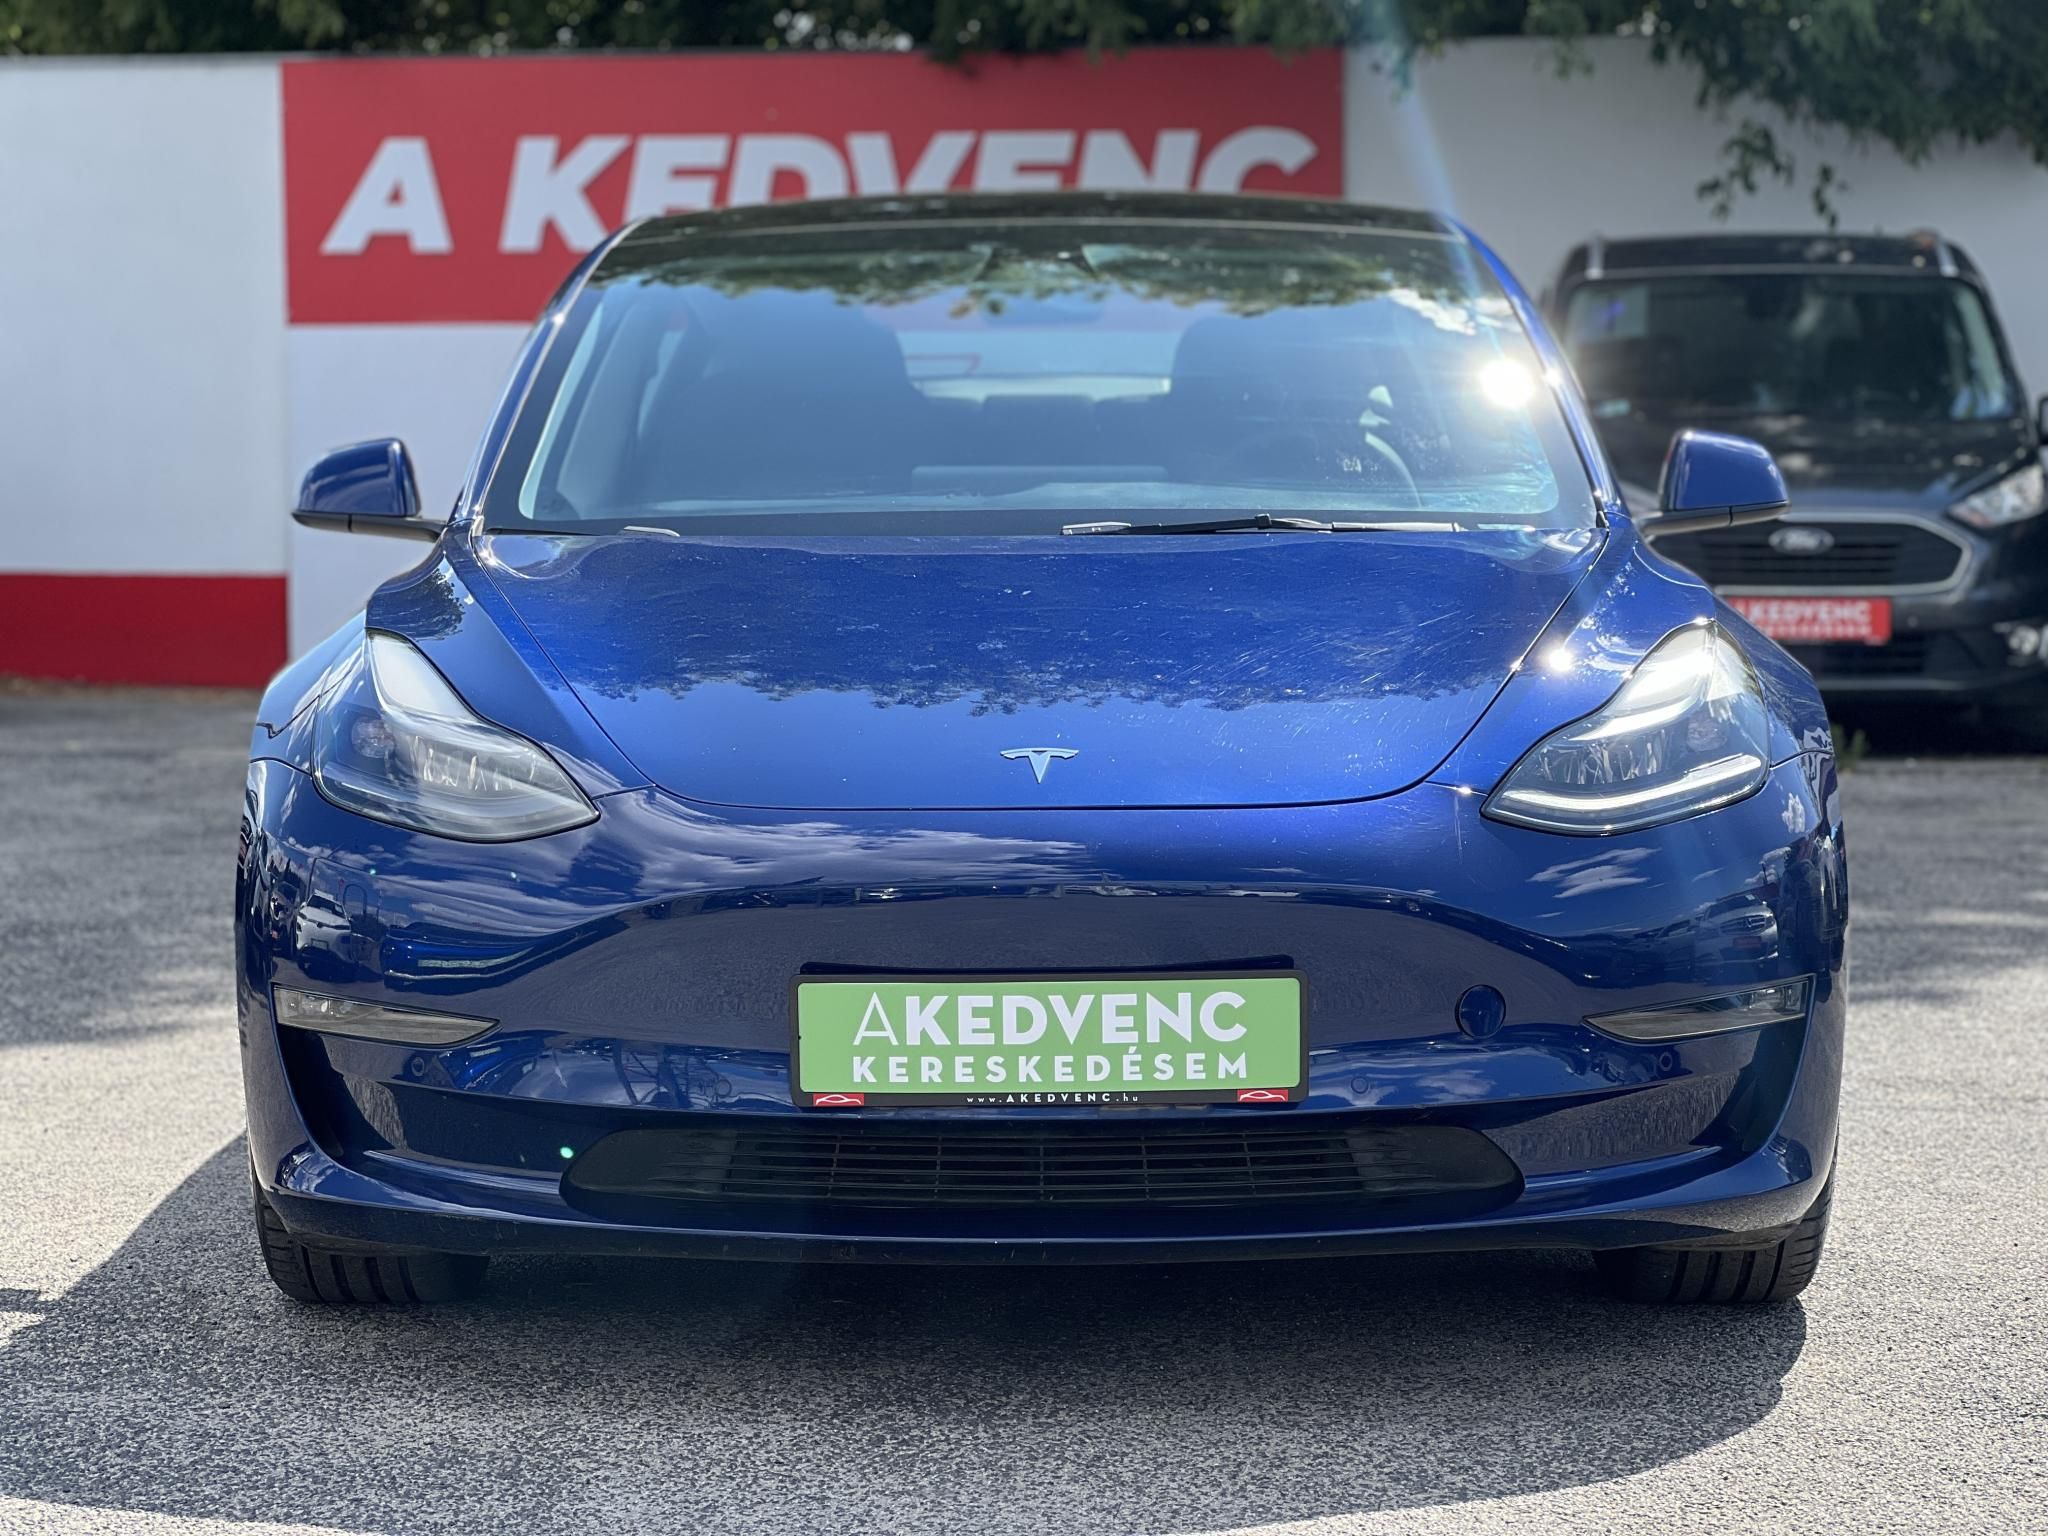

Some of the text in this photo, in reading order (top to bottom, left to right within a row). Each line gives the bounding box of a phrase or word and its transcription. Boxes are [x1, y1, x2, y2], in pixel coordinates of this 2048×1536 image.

[320, 136, 454, 254] A
[852, 1046, 1248, 1084] KERESKEDÉSEM
[966, 1092, 1139, 1103] www.AKEDVENC.hu
